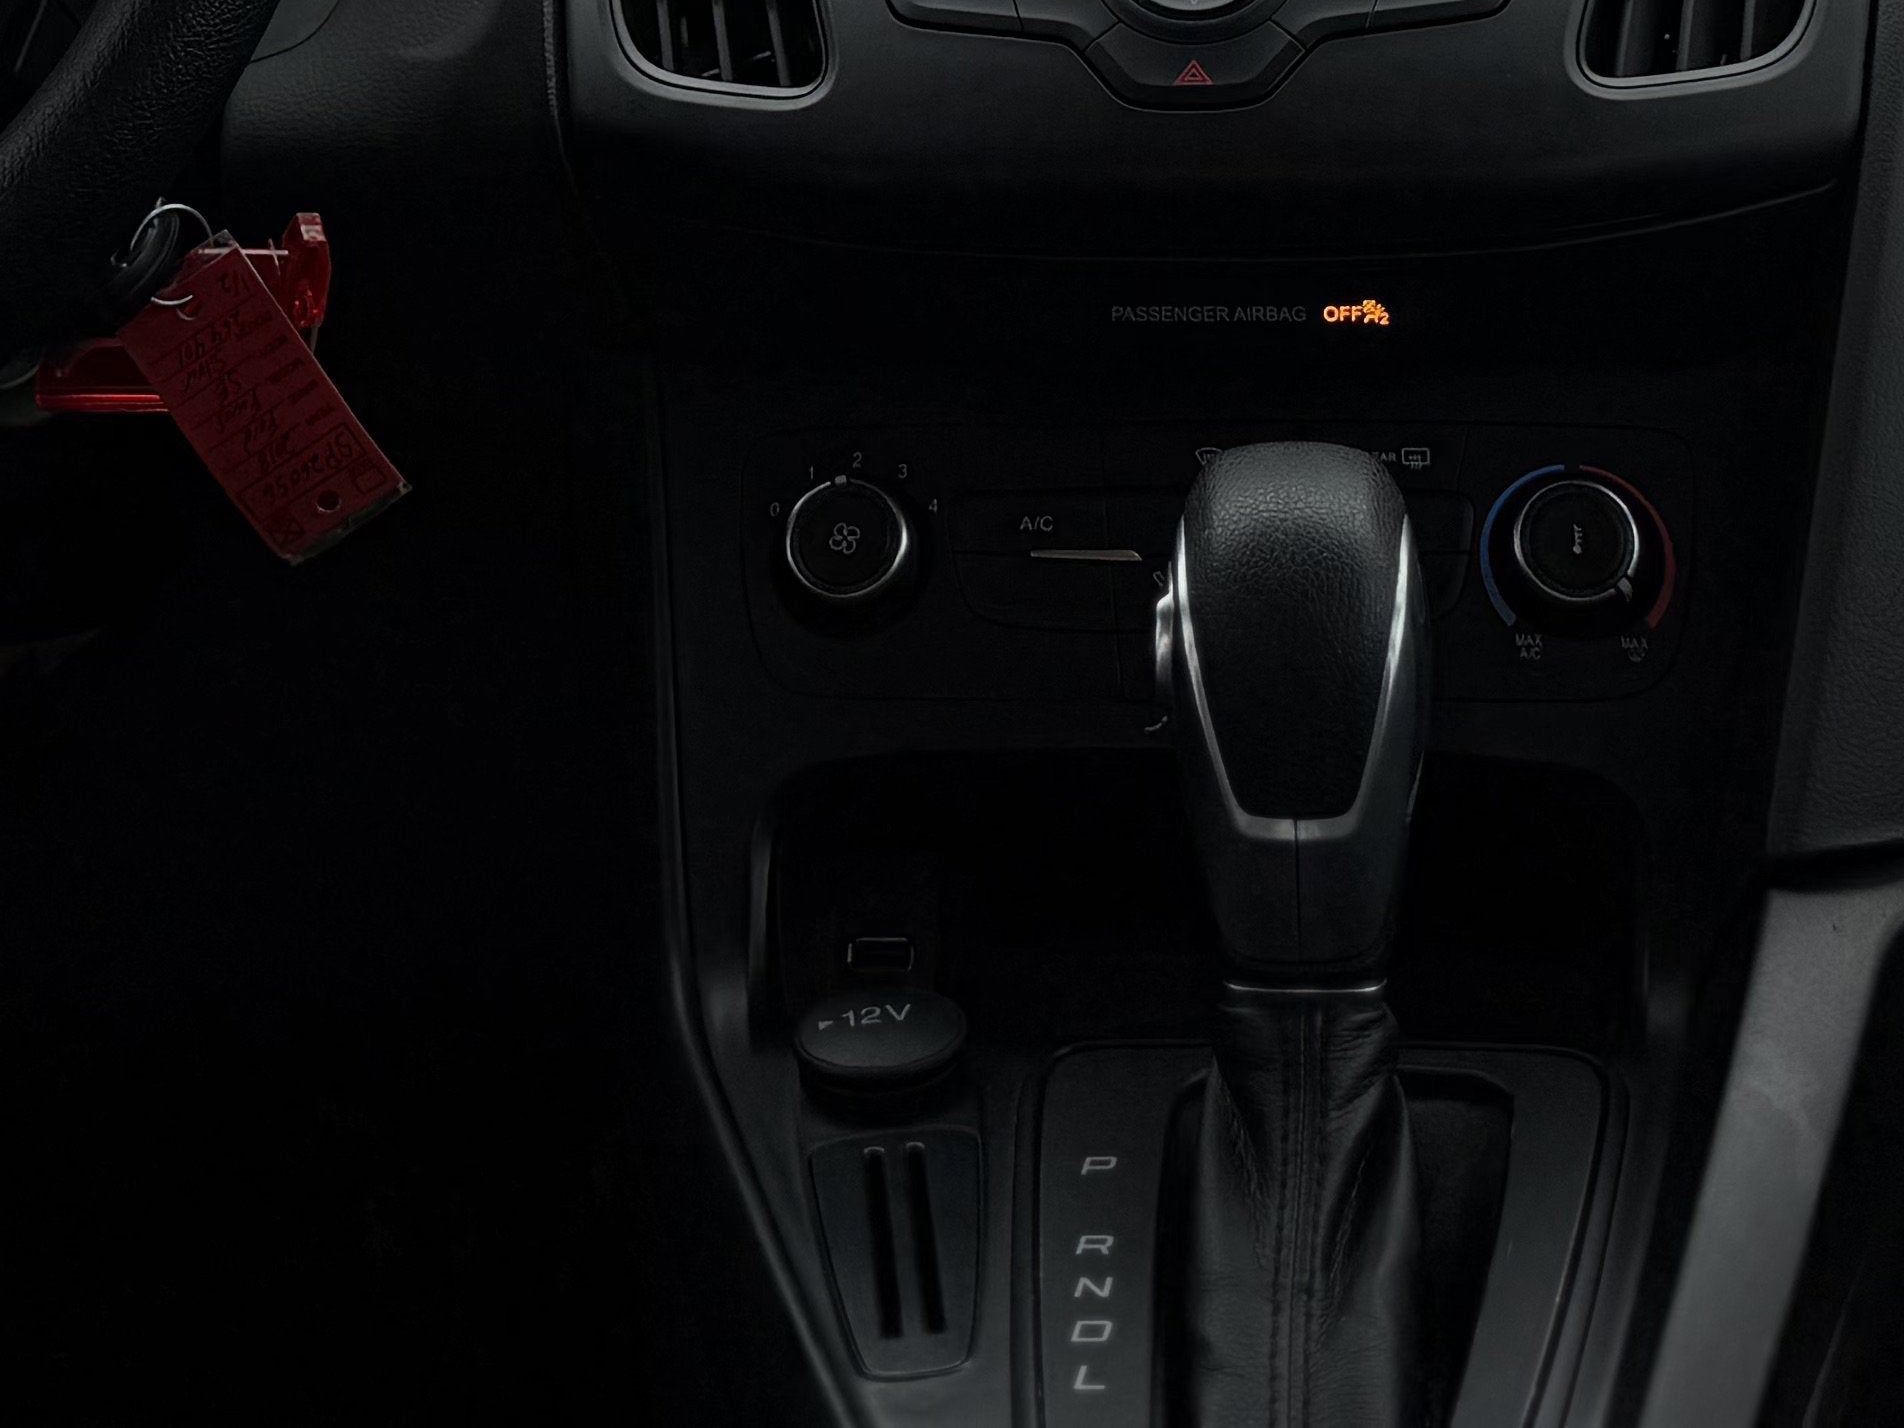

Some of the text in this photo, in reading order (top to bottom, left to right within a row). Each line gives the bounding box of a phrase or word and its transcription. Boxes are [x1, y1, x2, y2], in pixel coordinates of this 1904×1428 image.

[1111, 305, 1229, 323] PASSENGER
[1234, 305, 1307, 323] AIRBAG
[1323, 305, 1362, 323] OFF
[851, 451, 863, 470] 2
[1370, 451, 1397, 463] AR
[808, 465, 816, 482] 1
[896, 462, 909, 481] 3
[768, 500, 781, 519] 0
[927, 497, 941, 516] 4
[1019, 513, 1055, 534] A/C
[1514, 632, 1543, 646] MAX
[1520, 647, 1542, 660] A/C
[841, 1002, 912, 1028] 12V
[1080, 1156, 1117, 1176] P
[1075, 1235, 1114, 1256] R
[1074, 1277, 1113, 1299] N
[1070, 1320, 1113, 1343] D
[1072, 1364, 1105, 1391] L
